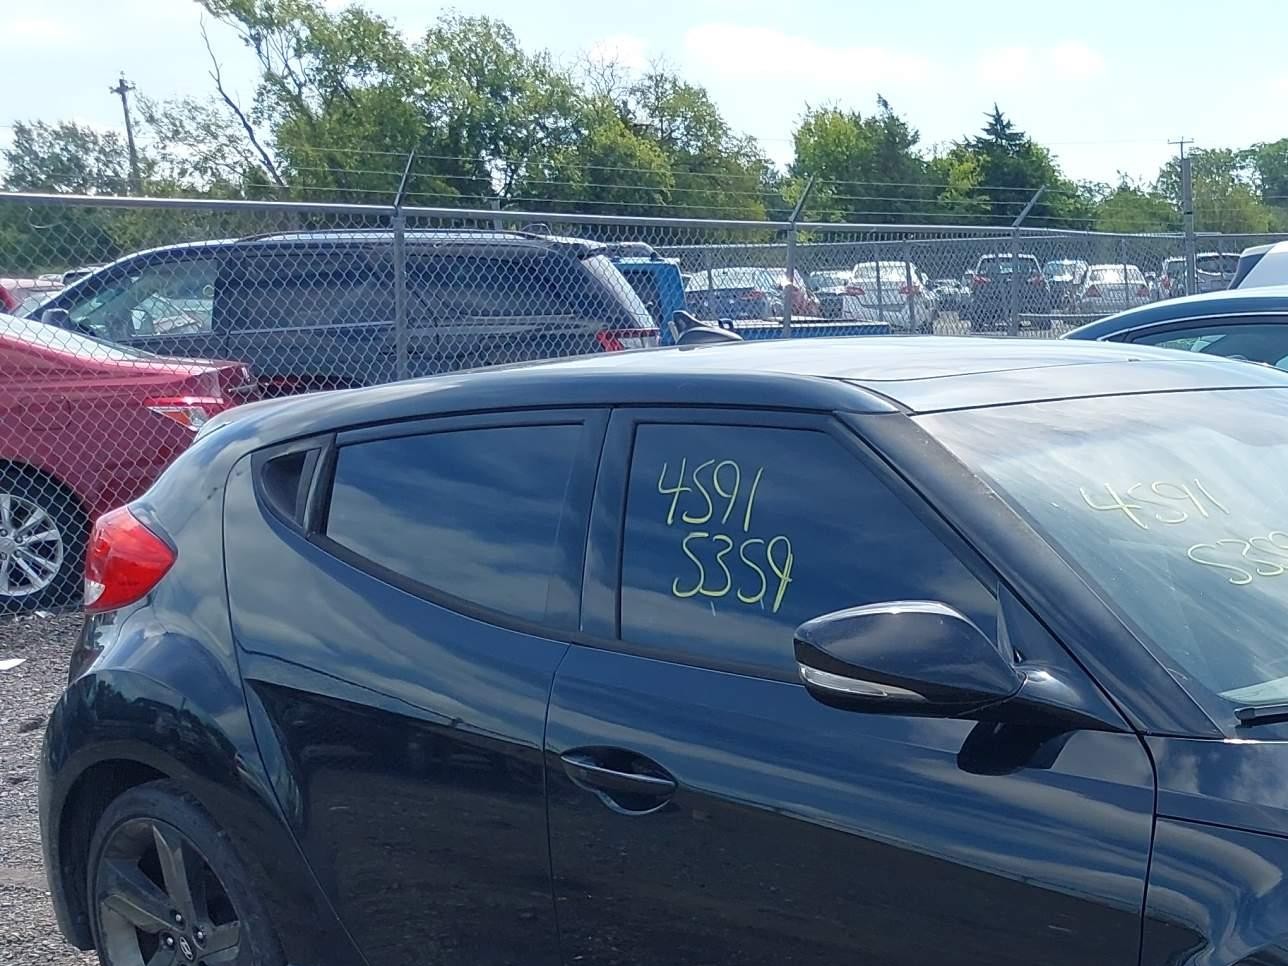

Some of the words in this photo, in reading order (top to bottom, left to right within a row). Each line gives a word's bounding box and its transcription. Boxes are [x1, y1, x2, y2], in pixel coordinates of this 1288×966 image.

[658, 456, 765, 533] 4591
[1079, 478, 1231, 531] 4591
[672, 531, 794, 614] 5359
